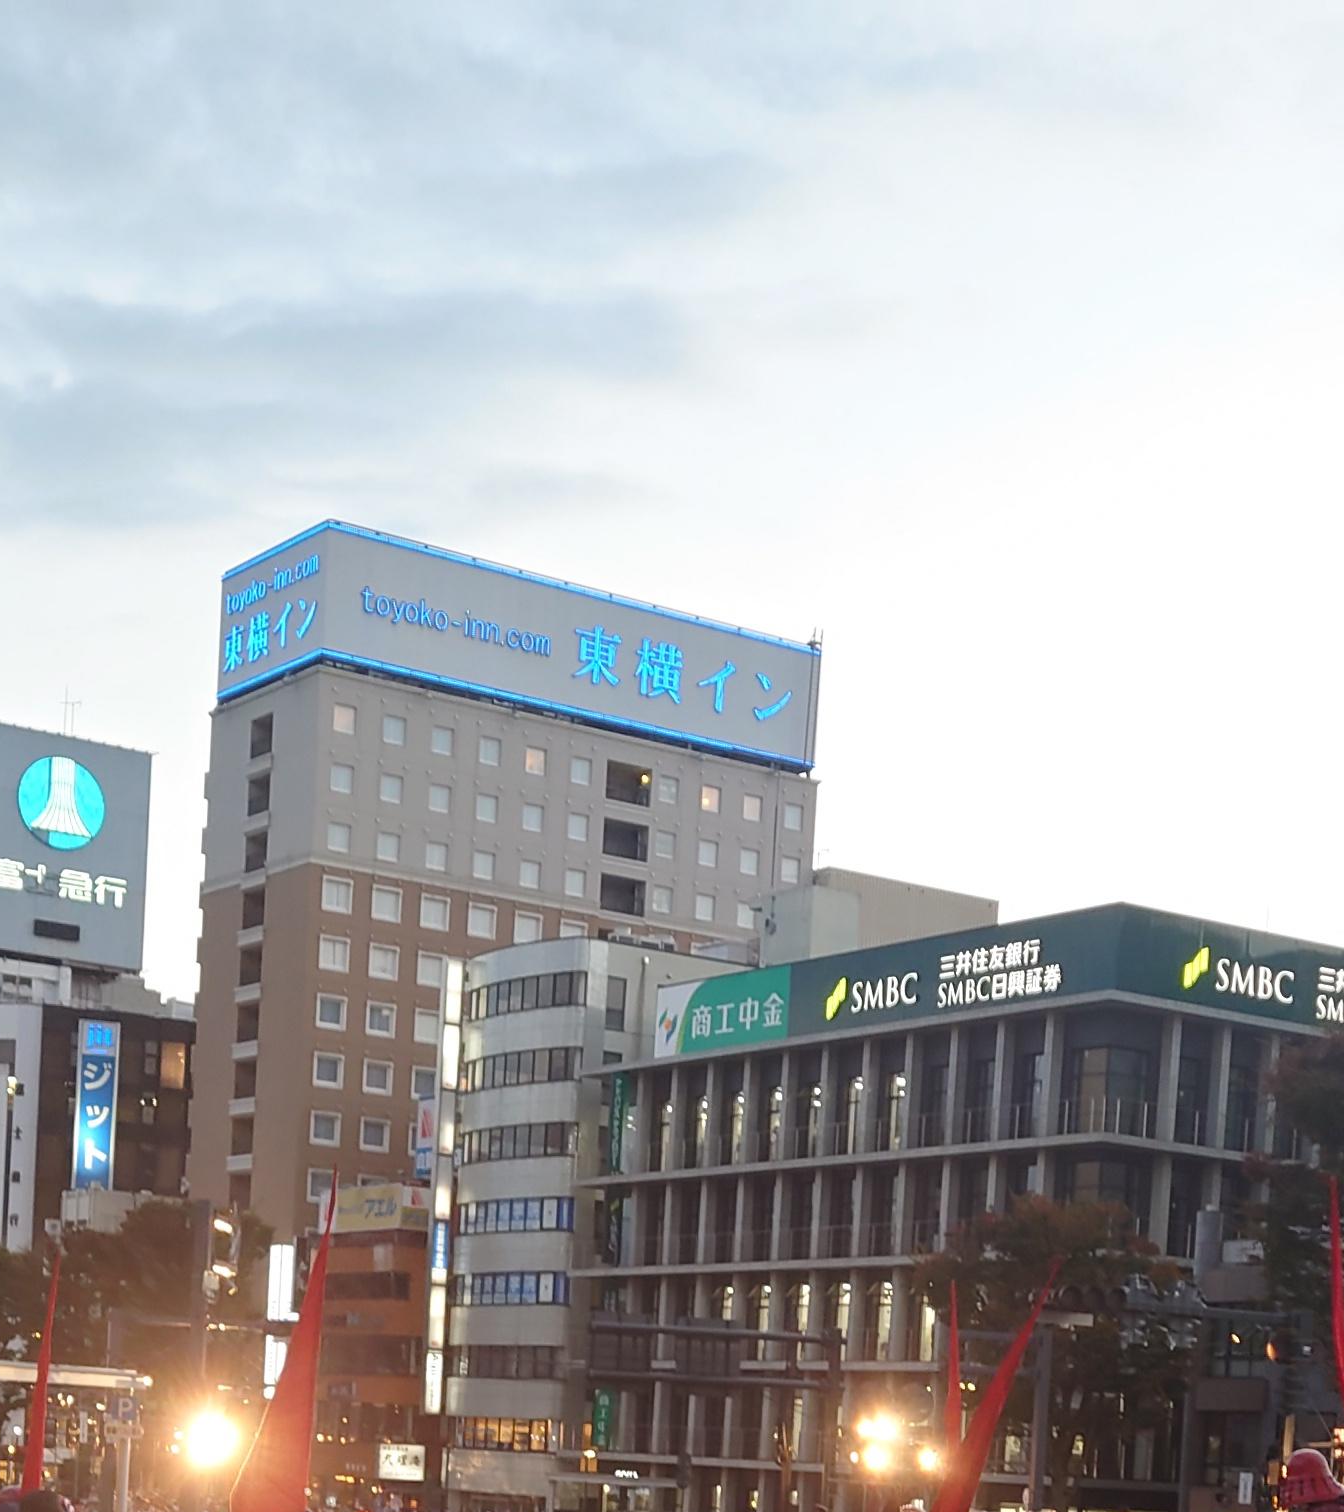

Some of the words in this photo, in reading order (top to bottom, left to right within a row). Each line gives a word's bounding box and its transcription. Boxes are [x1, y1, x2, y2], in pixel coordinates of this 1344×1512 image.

[225, 553, 320, 616] toyoko-inn.com
[223, 598, 318, 674] 東横イン
[360, 585, 552, 658] toyoko-inn.com
[572, 624, 792, 721] 東横イン
[937, 964, 1062, 1009] SMBC日興証券
[938, 938, 1041, 981] 三井住友銀行
[1216, 957, 1296, 1005] SMBC
[691, 992, 785, 1041] 商工中金
[850, 971, 919, 1014] SMBC
[83, 1061, 114, 1170] ジット
